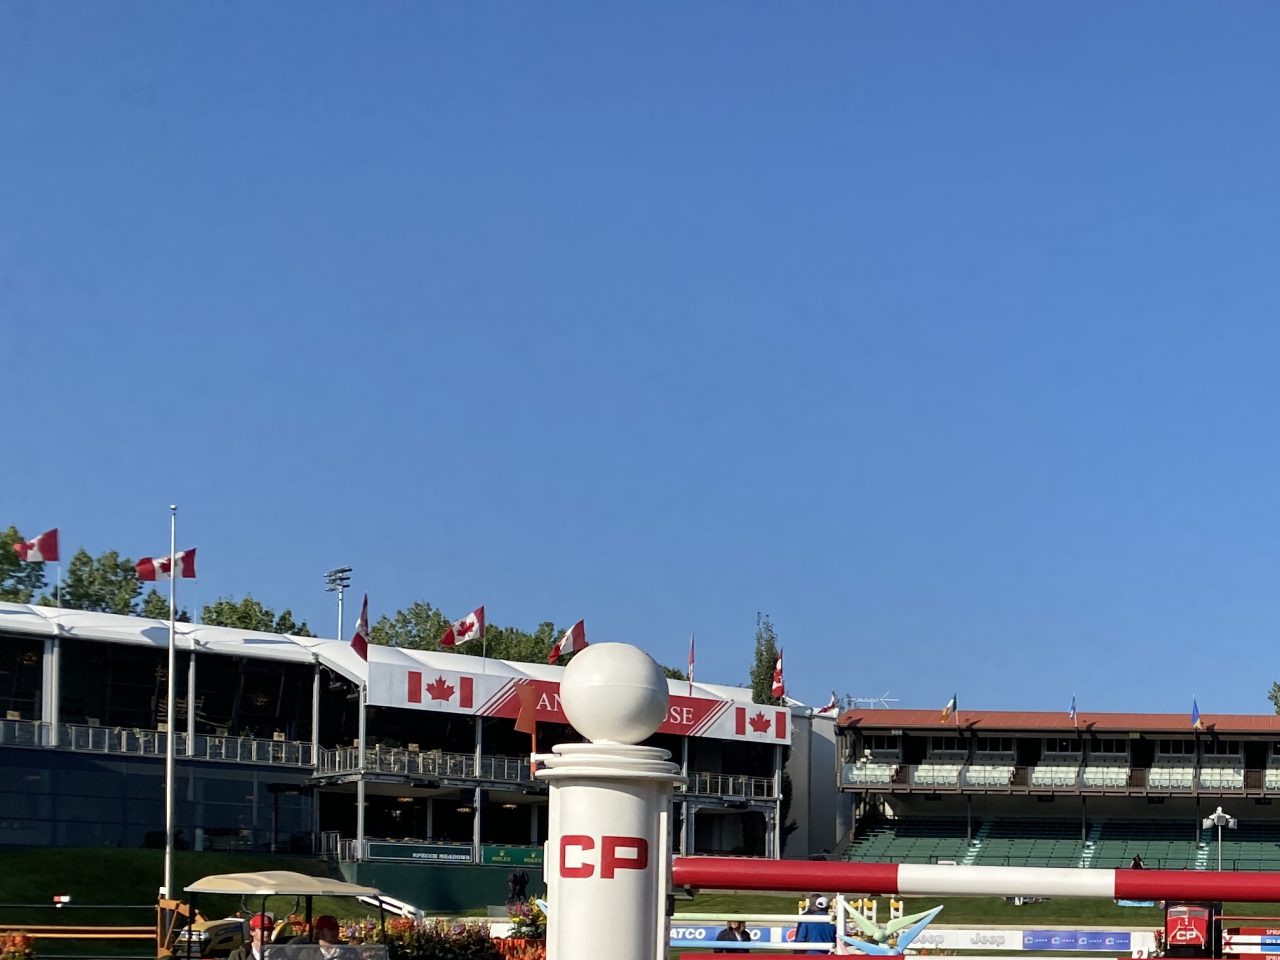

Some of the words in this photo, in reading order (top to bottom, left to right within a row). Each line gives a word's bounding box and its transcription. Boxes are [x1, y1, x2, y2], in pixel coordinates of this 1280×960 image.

[560, 835, 649, 879] CP
[969, 932, 1006, 946] Jeep
[1176, 931, 1196, 940] CP
